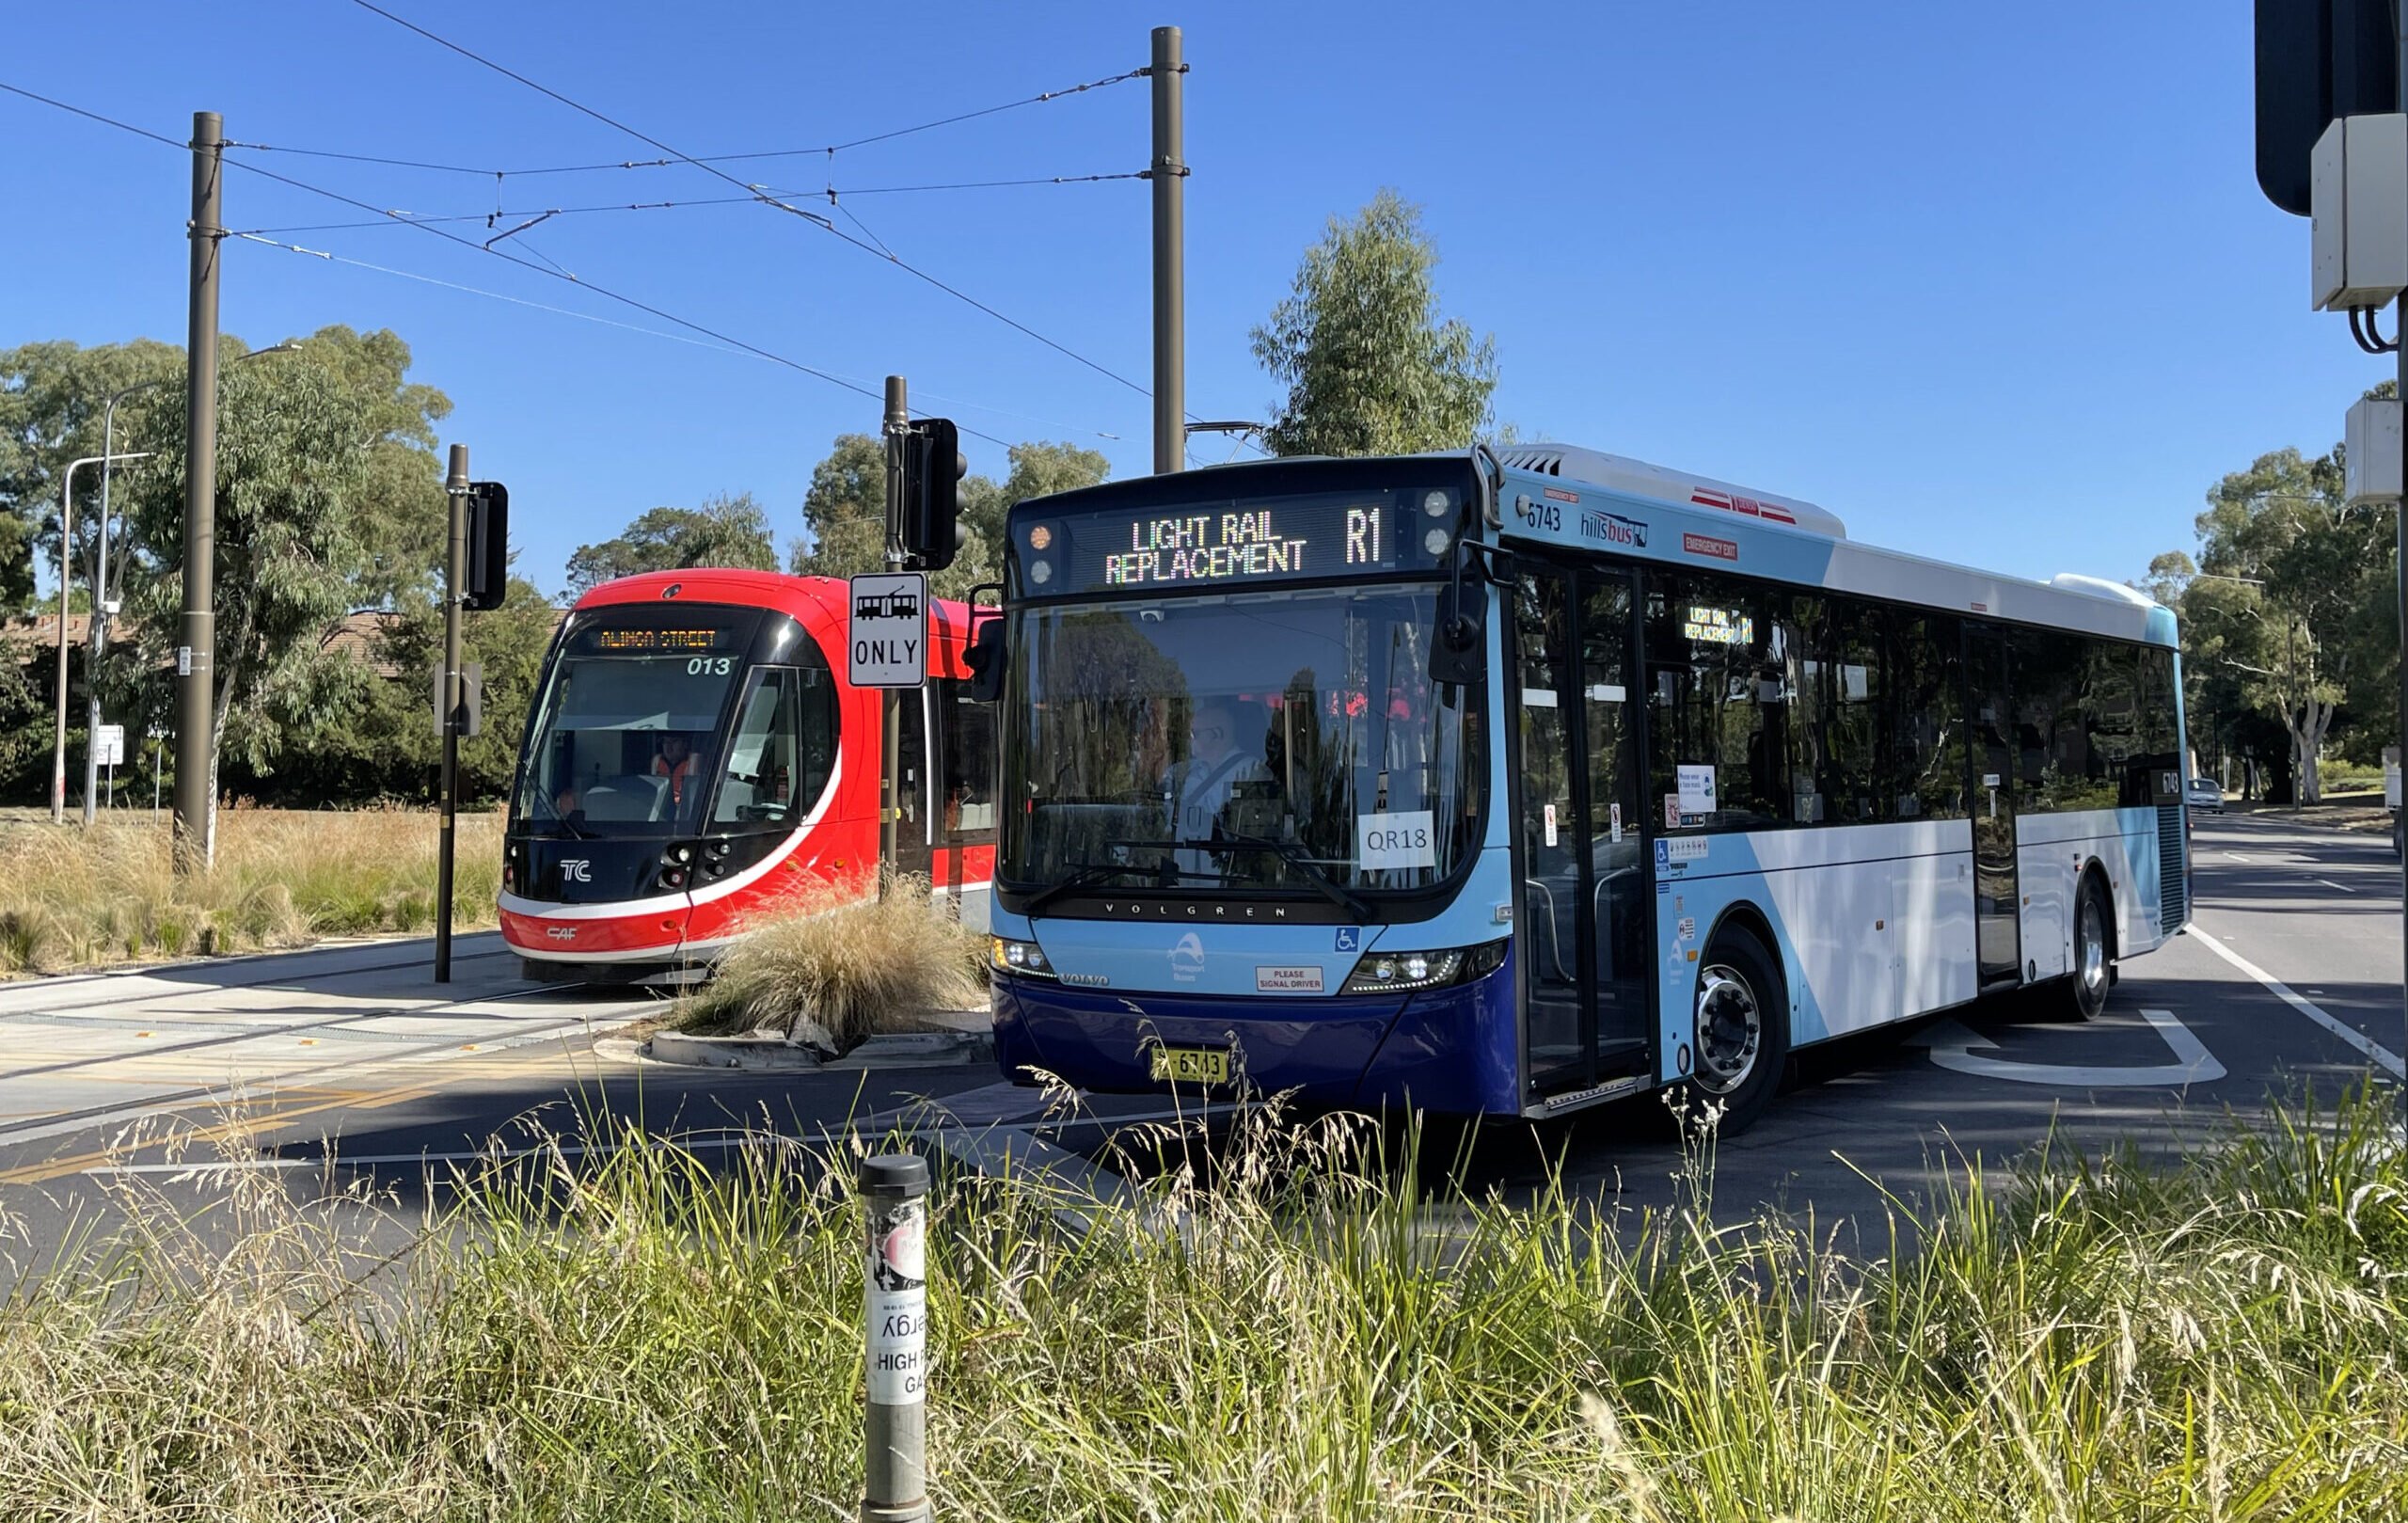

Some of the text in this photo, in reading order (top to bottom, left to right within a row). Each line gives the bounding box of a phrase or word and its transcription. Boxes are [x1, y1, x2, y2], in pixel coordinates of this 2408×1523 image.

[1528, 502, 1560, 531] 6743
[1132, 511, 1282, 551] LIGHT RAIL
[1346, 507, 1380, 563] R1
[1581, 513, 1632, 545] hillsbus
[1686, 536, 1736, 557] EMERGENCY EXIT
[1106, 540, 1307, 584] REPLACEMENT
[660, 630, 716, 647] STREET
[855, 640, 917, 665] ONLY
[687, 658, 731, 675] 013
[1368, 829, 1427, 852] QR18
[560, 859, 592, 882] TC
[1105, 903, 1285, 917] VOLGREN
[547, 927, 578, 941] CAF
[1060, 973, 1110, 986] VOLVO
[1259, 979, 1321, 988] SIGNAL DRIVER
[1274, 970, 1305, 978] PLEASE
[878, 1351, 917, 1371] HIGH
[905, 1374, 925, 1393] GA
